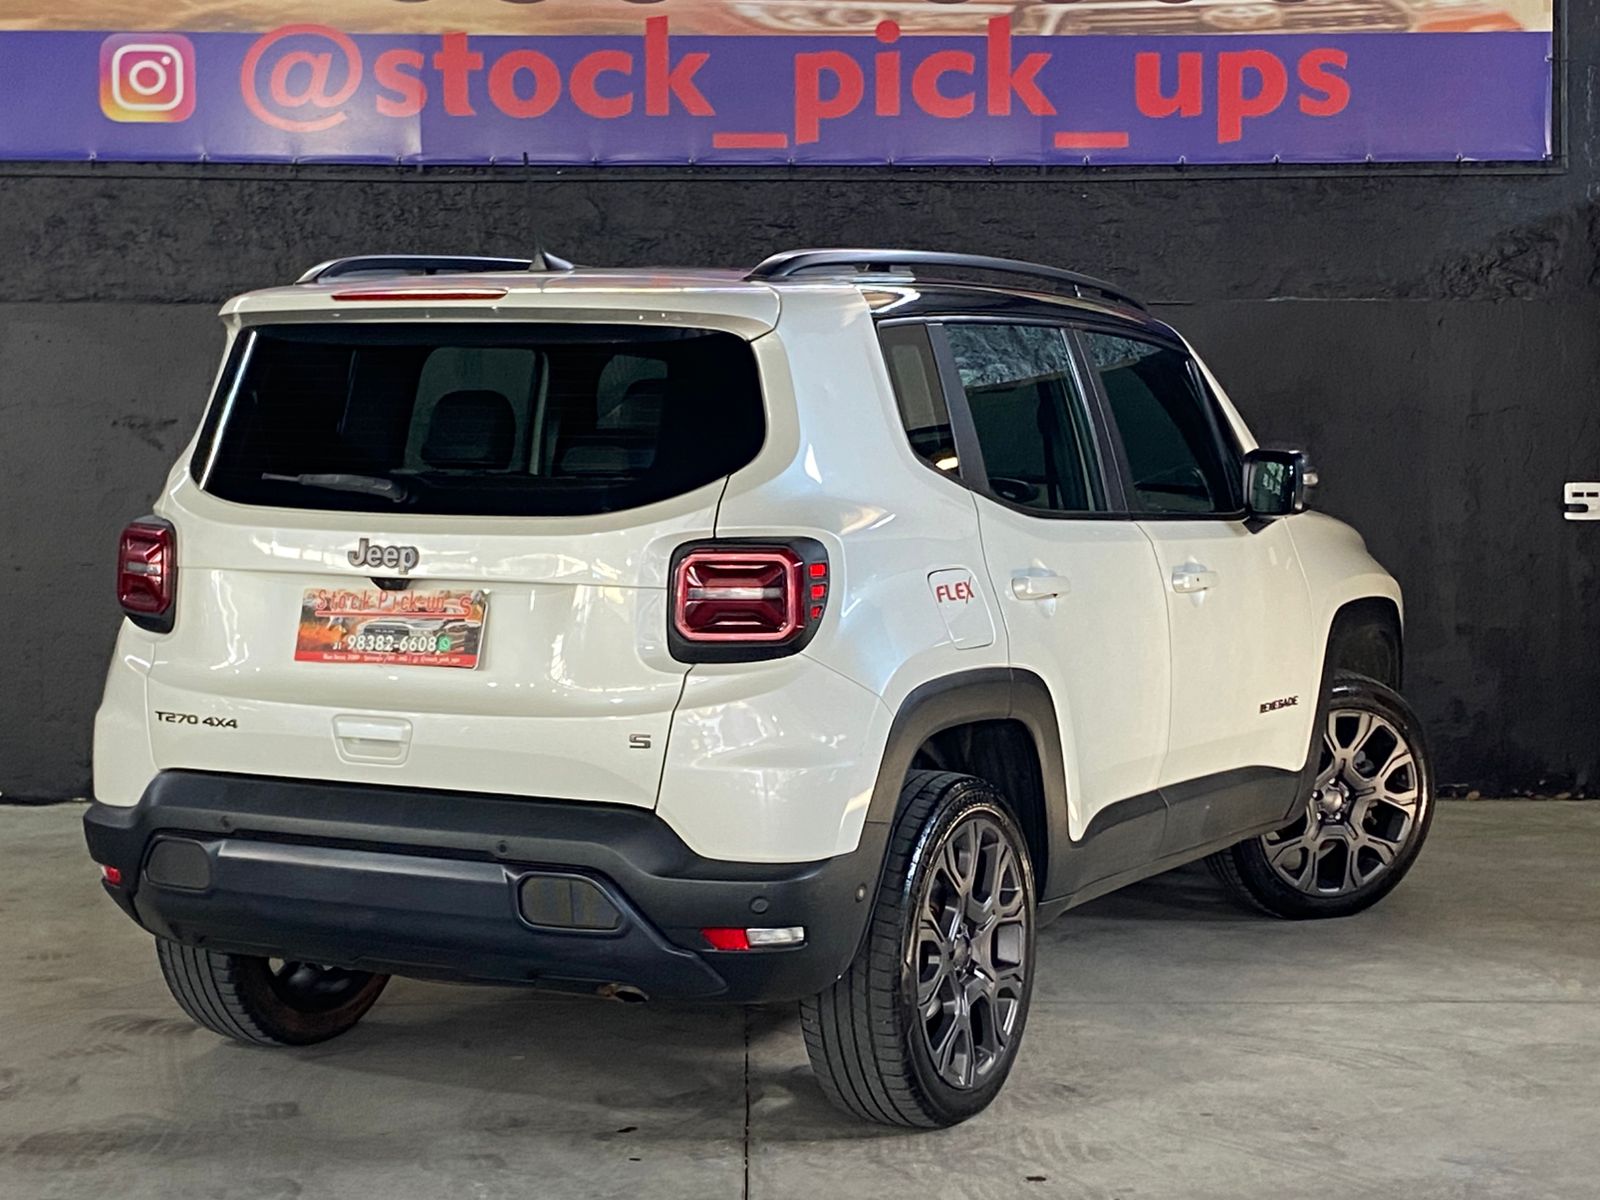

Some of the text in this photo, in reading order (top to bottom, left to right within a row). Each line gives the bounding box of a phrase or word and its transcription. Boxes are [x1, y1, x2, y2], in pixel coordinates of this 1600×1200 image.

[240, 16, 1351, 148] @stock_pick_ups
[347, 538, 420, 575] Jeep
[316, 588, 370, 610] Stock
[936, 576, 975, 604] FLEX
[346, 635, 437, 652] 98382-6608
[1259, 695, 1299, 713] RENEGADE
[154, 710, 199, 725] T270
[629, 733, 652, 749] S
